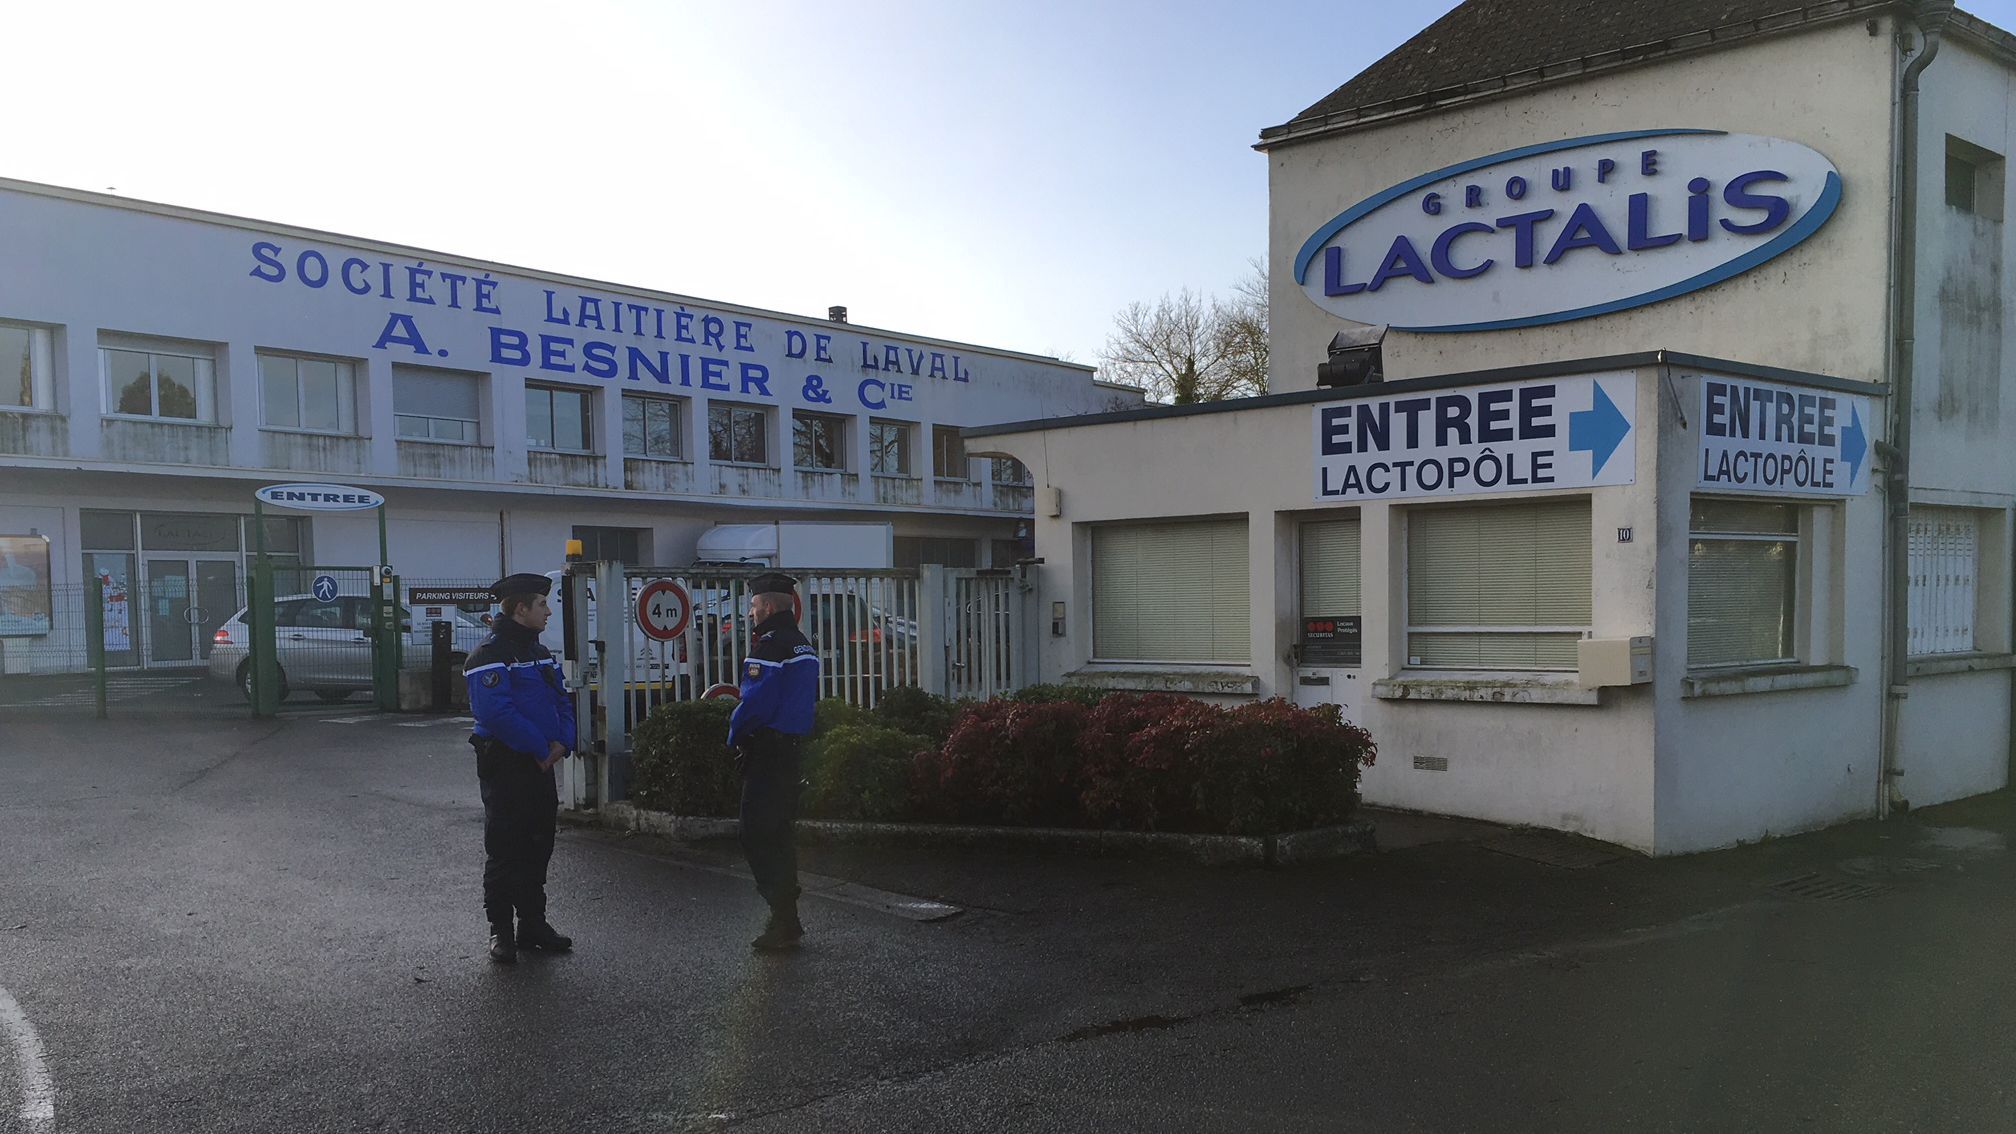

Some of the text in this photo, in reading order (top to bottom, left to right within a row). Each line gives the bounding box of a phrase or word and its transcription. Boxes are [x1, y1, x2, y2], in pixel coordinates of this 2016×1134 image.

[1421, 149, 1658, 215] GROUPE
[249, 241, 970, 383] SOCIÉTÉ LAITIÈRE DE LAVAL
[371, 312, 449, 358] A.
[488, 326, 774, 397] BESNIER
[801, 374, 833, 404] &
[1321, 384, 1556, 456] ENTREE
[1705, 381, 1836, 448] ENTREE
[1321, 447, 1555, 497] LACTOPÔLE
[1703, 448, 1835, 488] LACTOPÔLE
[270, 490, 372, 504] ENTREE
[1619, 527, 1631, 542] 10
[415, 592, 490, 600] PARKING VISITEURS
[652, 603, 678, 618] 4 m
